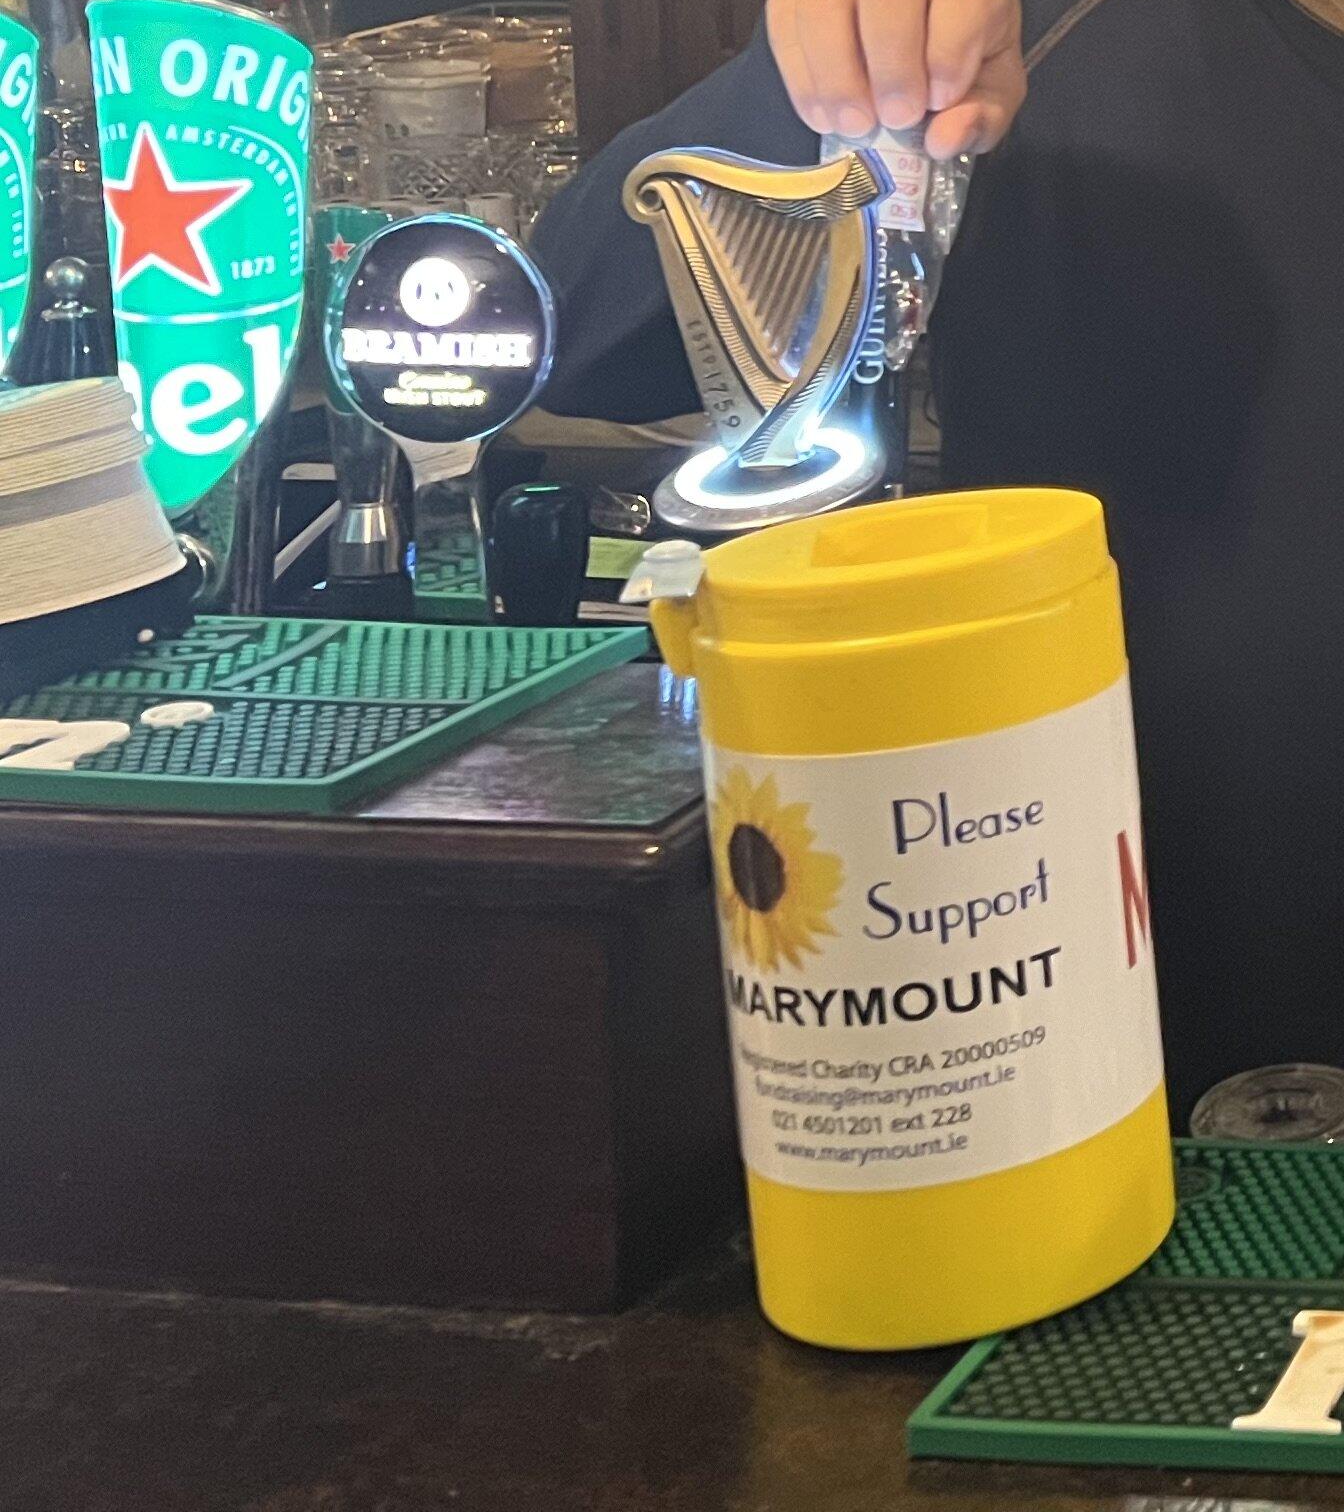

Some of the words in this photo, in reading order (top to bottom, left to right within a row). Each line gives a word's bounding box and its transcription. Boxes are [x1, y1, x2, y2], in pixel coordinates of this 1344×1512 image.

[891, 790, 1045, 856] Please
[862, 856, 1050, 945] Support
[727, 945, 1063, 1029] MARYMOUNT
[811, 1057, 883, 1084] Charity
[888, 1053, 936, 1078] CRA
[940, 1025, 1048, 1071] 20000509
[774, 1130, 969, 1168] www.marymount.ie
[889, 1112, 926, 1134] ext
[931, 1102, 974, 1128] 228
